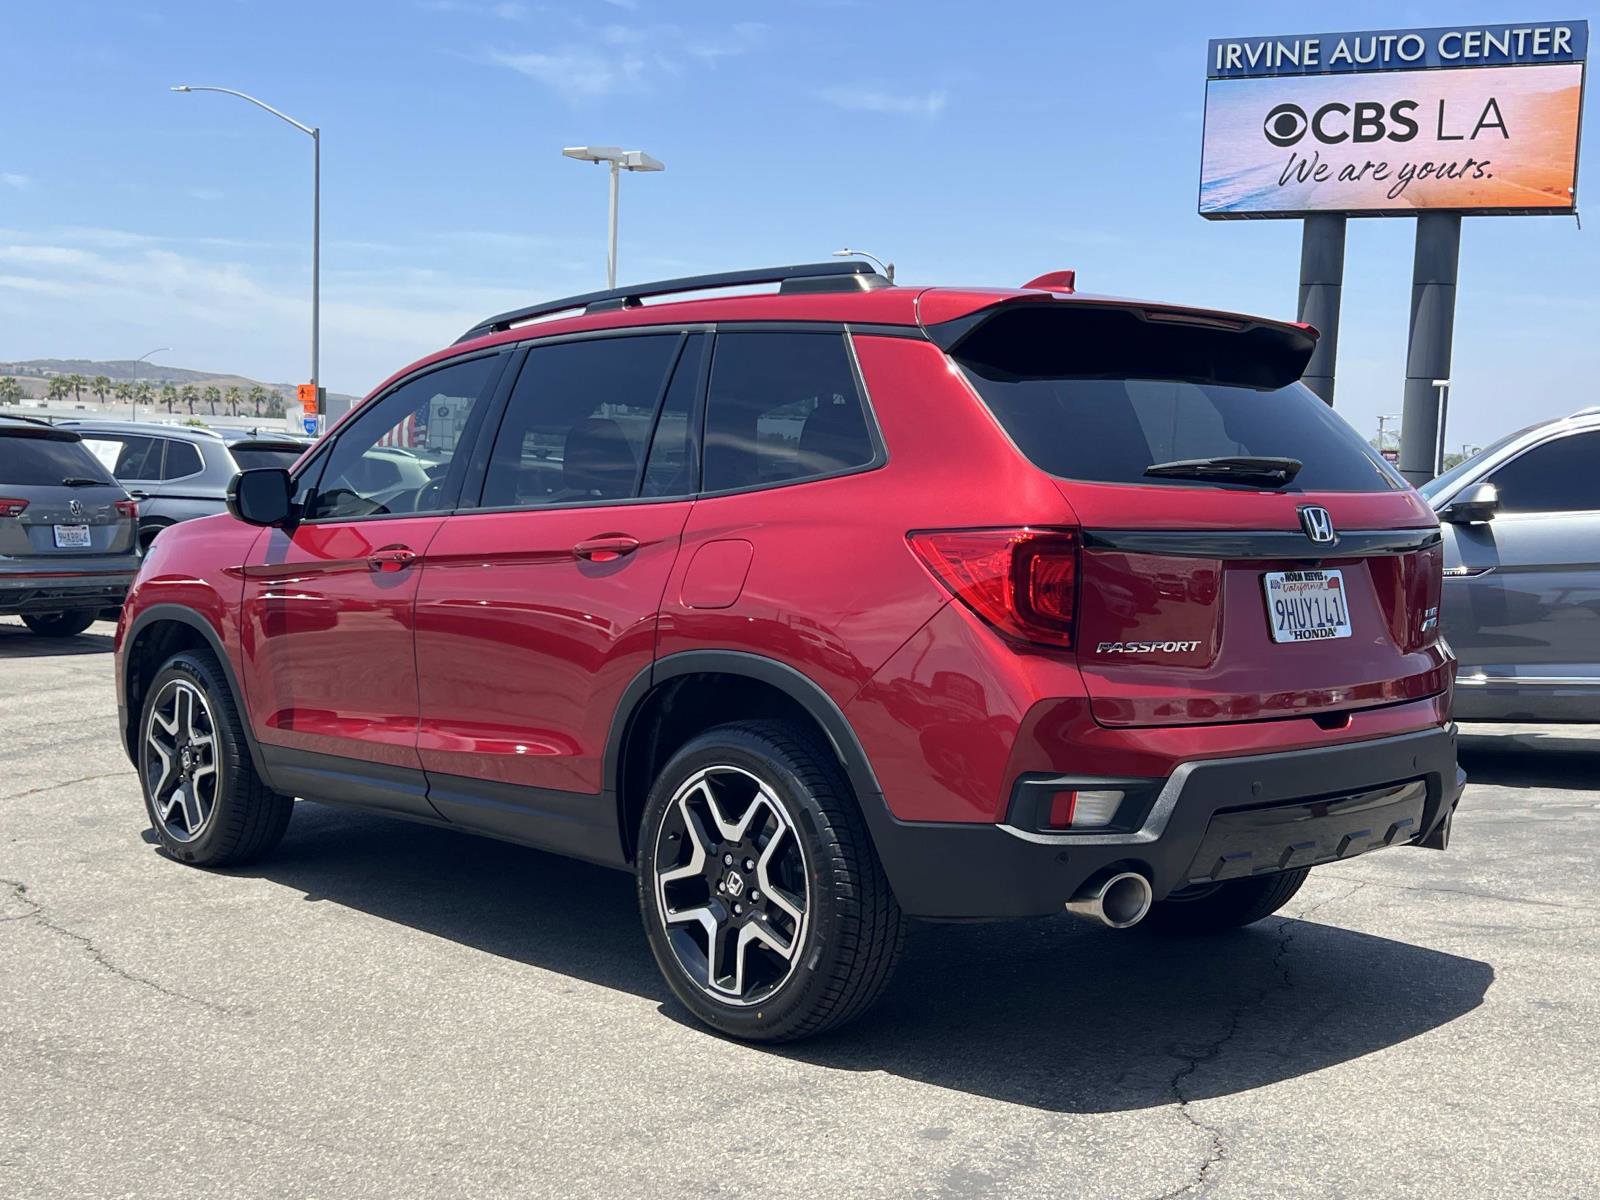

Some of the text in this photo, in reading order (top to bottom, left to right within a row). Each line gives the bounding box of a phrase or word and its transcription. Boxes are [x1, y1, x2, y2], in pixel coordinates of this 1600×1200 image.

[1216, 26, 1573, 70] IRVINE AUTO CENTER
[1311, 97, 1510, 145] CBS LA
[1278, 150, 1494, 200] We are yours.
[1284, 571, 1324, 582] NORM REEVES
[1275, 596, 1345, 631] 9HUY141
[1095, 640, 1202, 654] PASSPORT
[1293, 627, 1336, 640] HONDA
